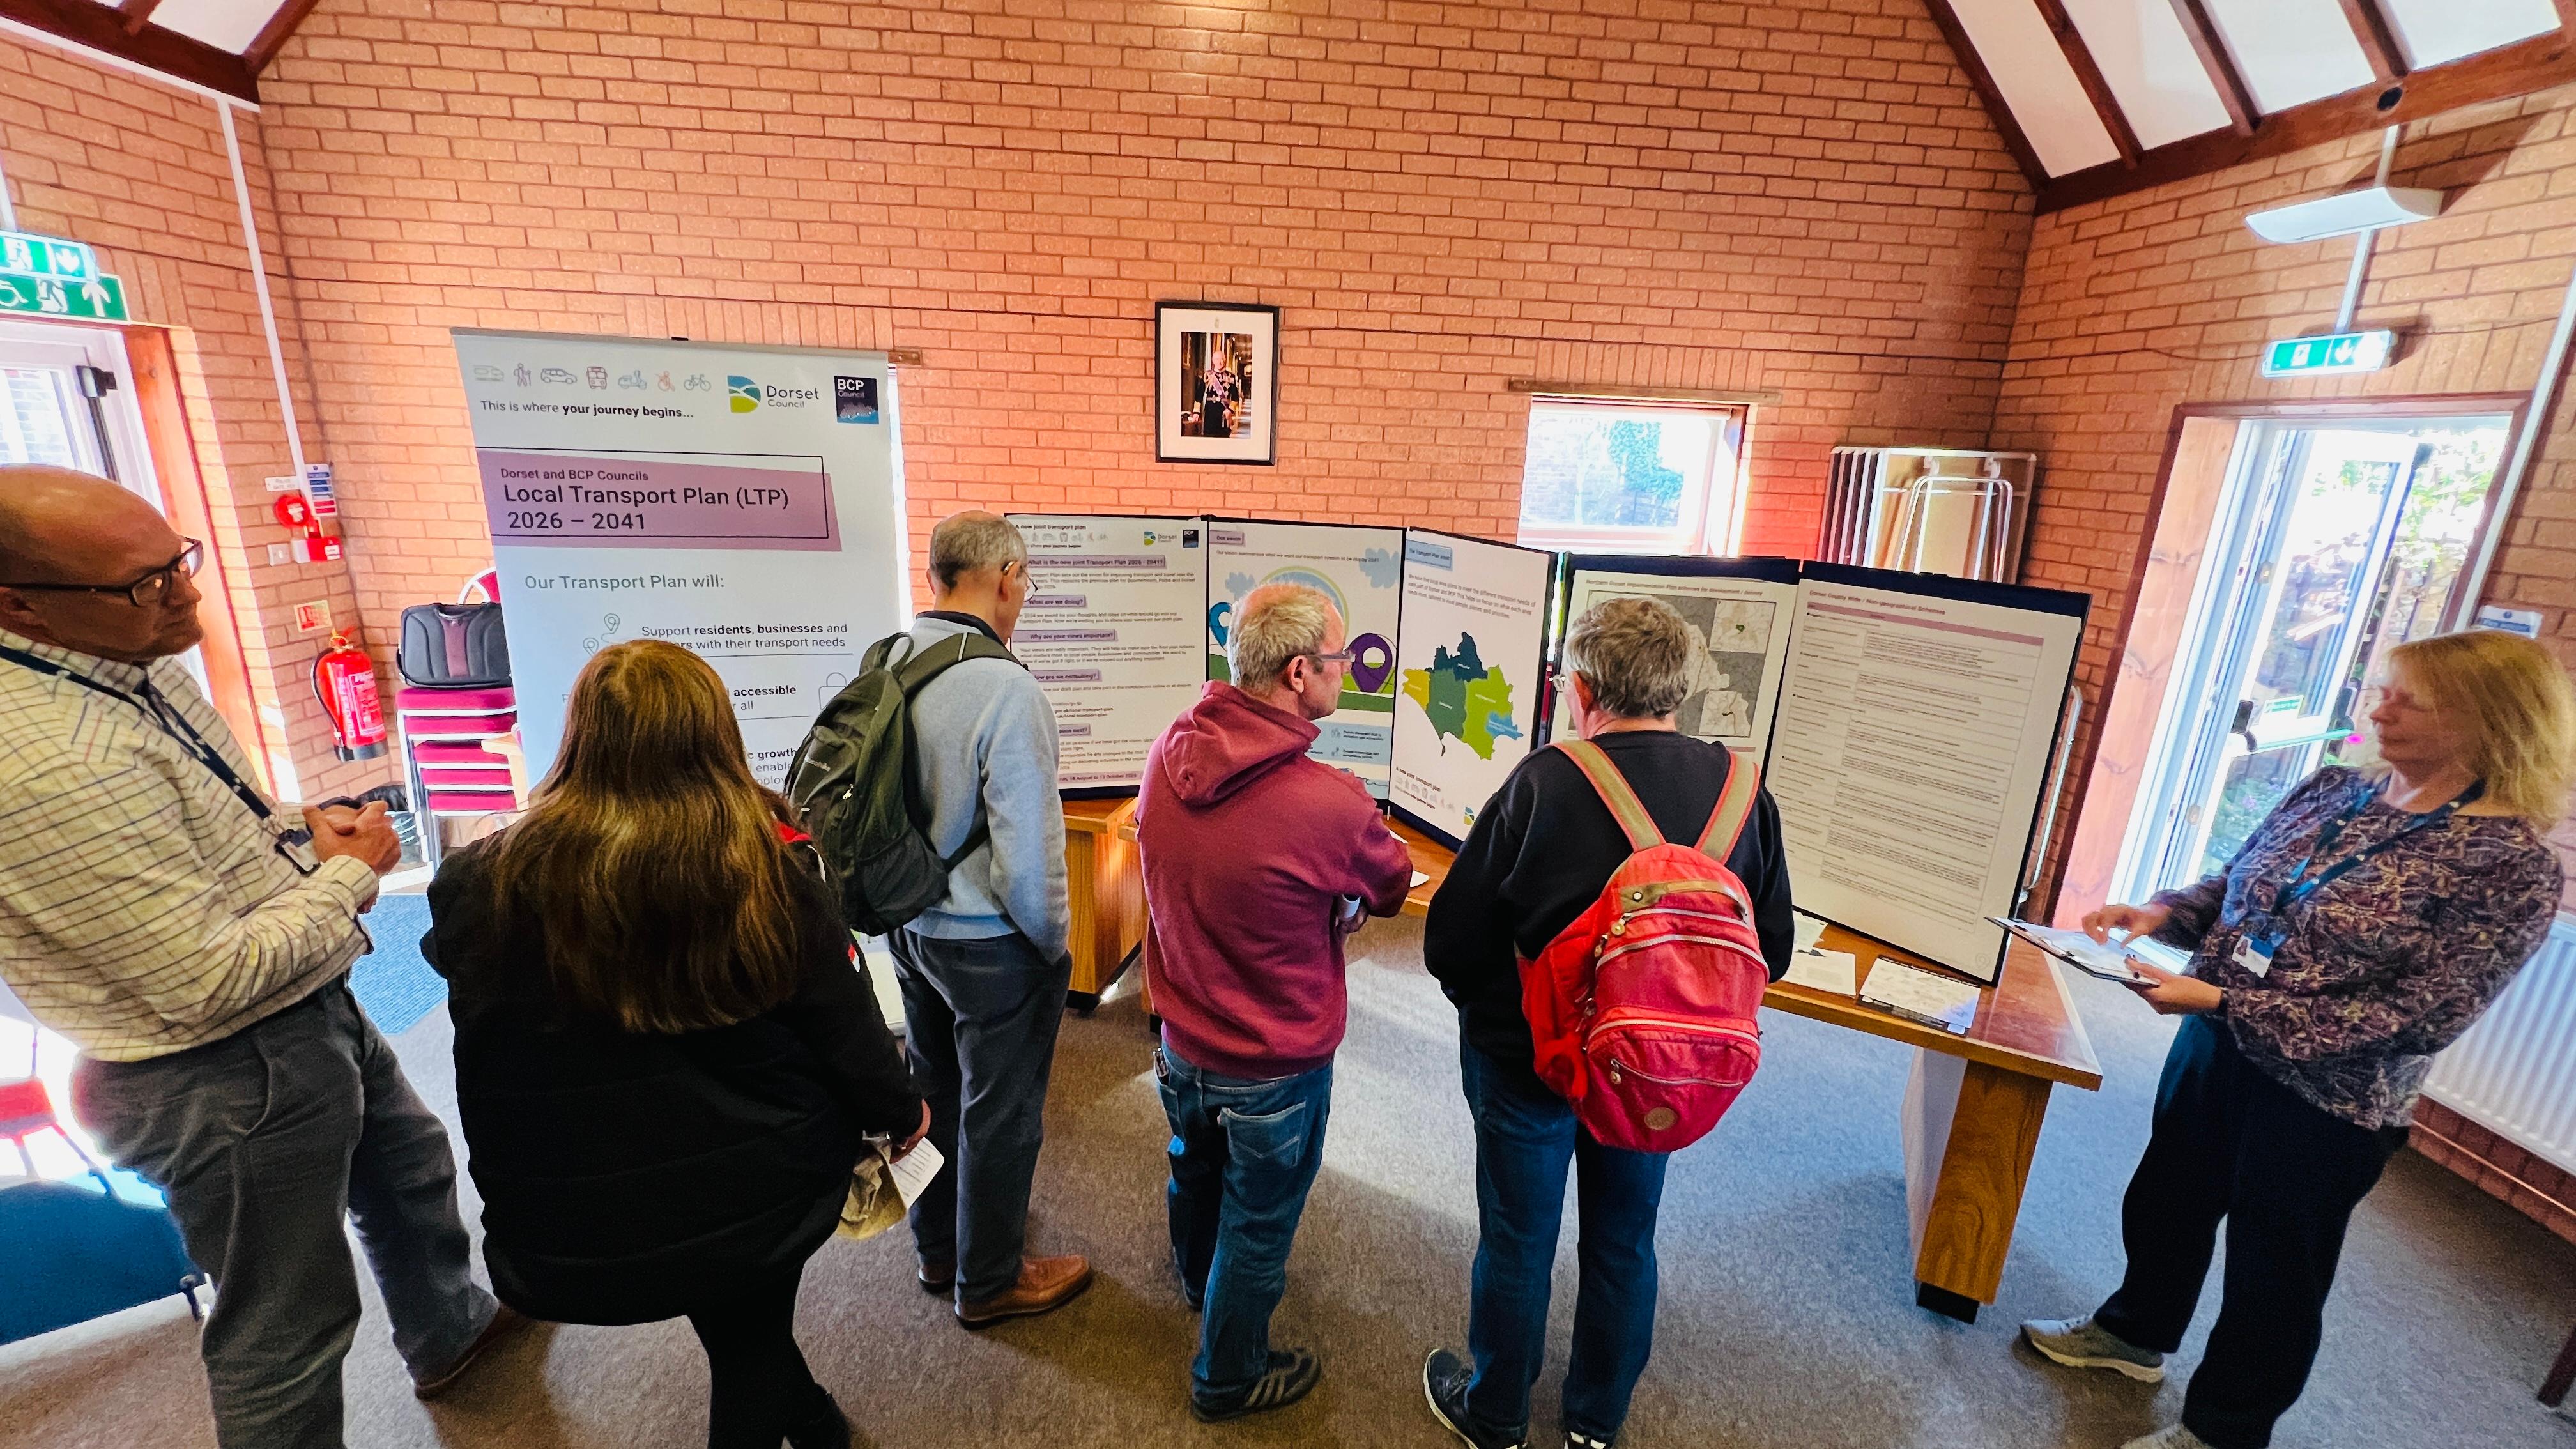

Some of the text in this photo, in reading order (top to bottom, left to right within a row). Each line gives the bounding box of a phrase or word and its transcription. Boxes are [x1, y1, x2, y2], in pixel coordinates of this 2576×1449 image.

[837, 378, 864, 391] BCP
[766, 385, 820, 400] Dorset
[838, 390, 865, 399] Council
[480, 400, 694, 418] This is where your journey begins...
[767, 399, 805, 408] Council
[500, 468, 648, 480] Dorset and BCP Councils
[503, 484, 788, 509] Local Transport Plan (LTP)
[507, 511, 564, 529] 2026
[592, 512, 645, 530] 2041
[525, 574, 724, 592] Our Transport Plan will:
[641, 624, 848, 638] Support residents, businesses and
[696, 639, 722, 650] with
[725, 638, 752, 648] their
[755, 638, 809, 650] transport
[812, 637, 845, 647] needs
[733, 685, 797, 697] accessible
[740, 700, 754, 710] all
[757, 747, 798, 761] growth
